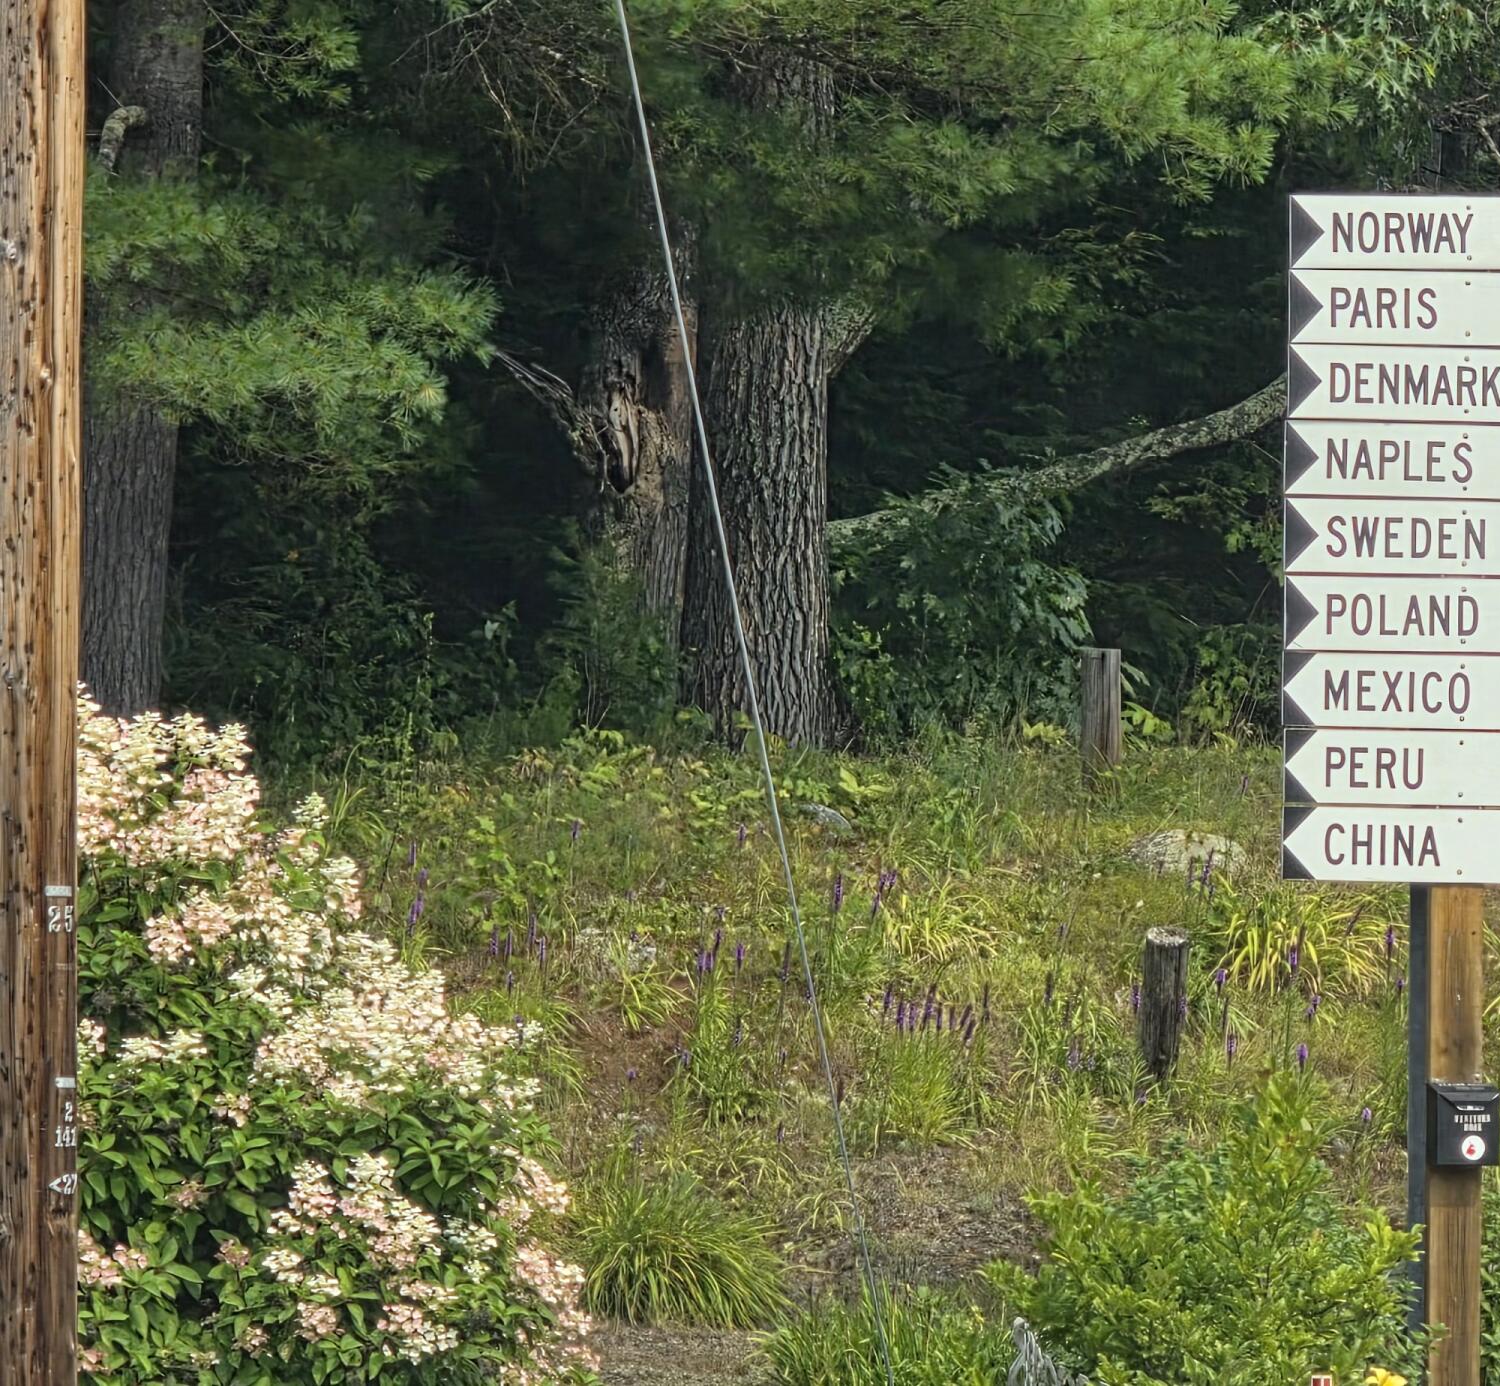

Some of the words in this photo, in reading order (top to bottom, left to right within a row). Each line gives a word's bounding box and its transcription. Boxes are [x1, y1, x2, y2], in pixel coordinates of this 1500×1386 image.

[1333, 211, 1473, 253] NORWAY
[1331, 287, 1437, 329] PARIS
[1327, 438, 1472, 483] NAPLES
[1327, 515, 1485, 559] SWEDEN
[1327, 594, 1478, 636] POLAND
[1325, 670, 1470, 714] MEXICO
[1326, 747, 1423, 789] PERU
[1325, 824, 1440, 866] CHINA
[47, 905, 74, 933] 25
